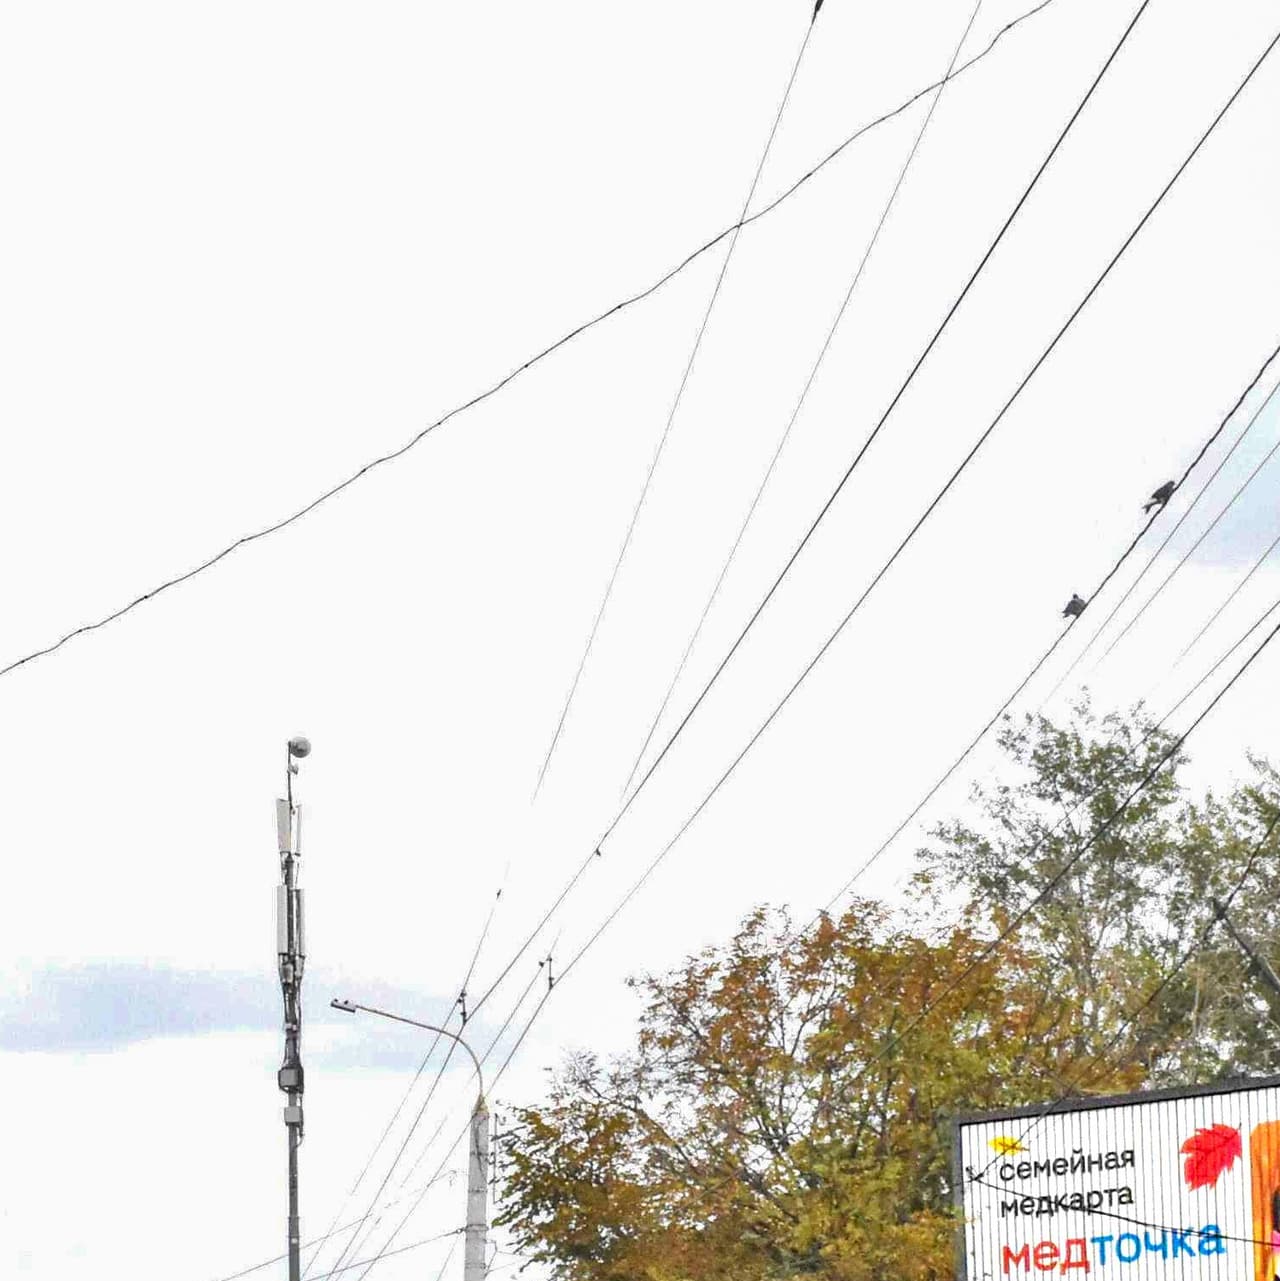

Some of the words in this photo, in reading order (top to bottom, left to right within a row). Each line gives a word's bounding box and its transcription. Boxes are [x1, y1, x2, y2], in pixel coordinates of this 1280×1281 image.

[999, 1148, 1136, 1181] семейная
[1000, 1186, 1134, 1218] медкарта
[1002, 1224, 1226, 1276] медточка
